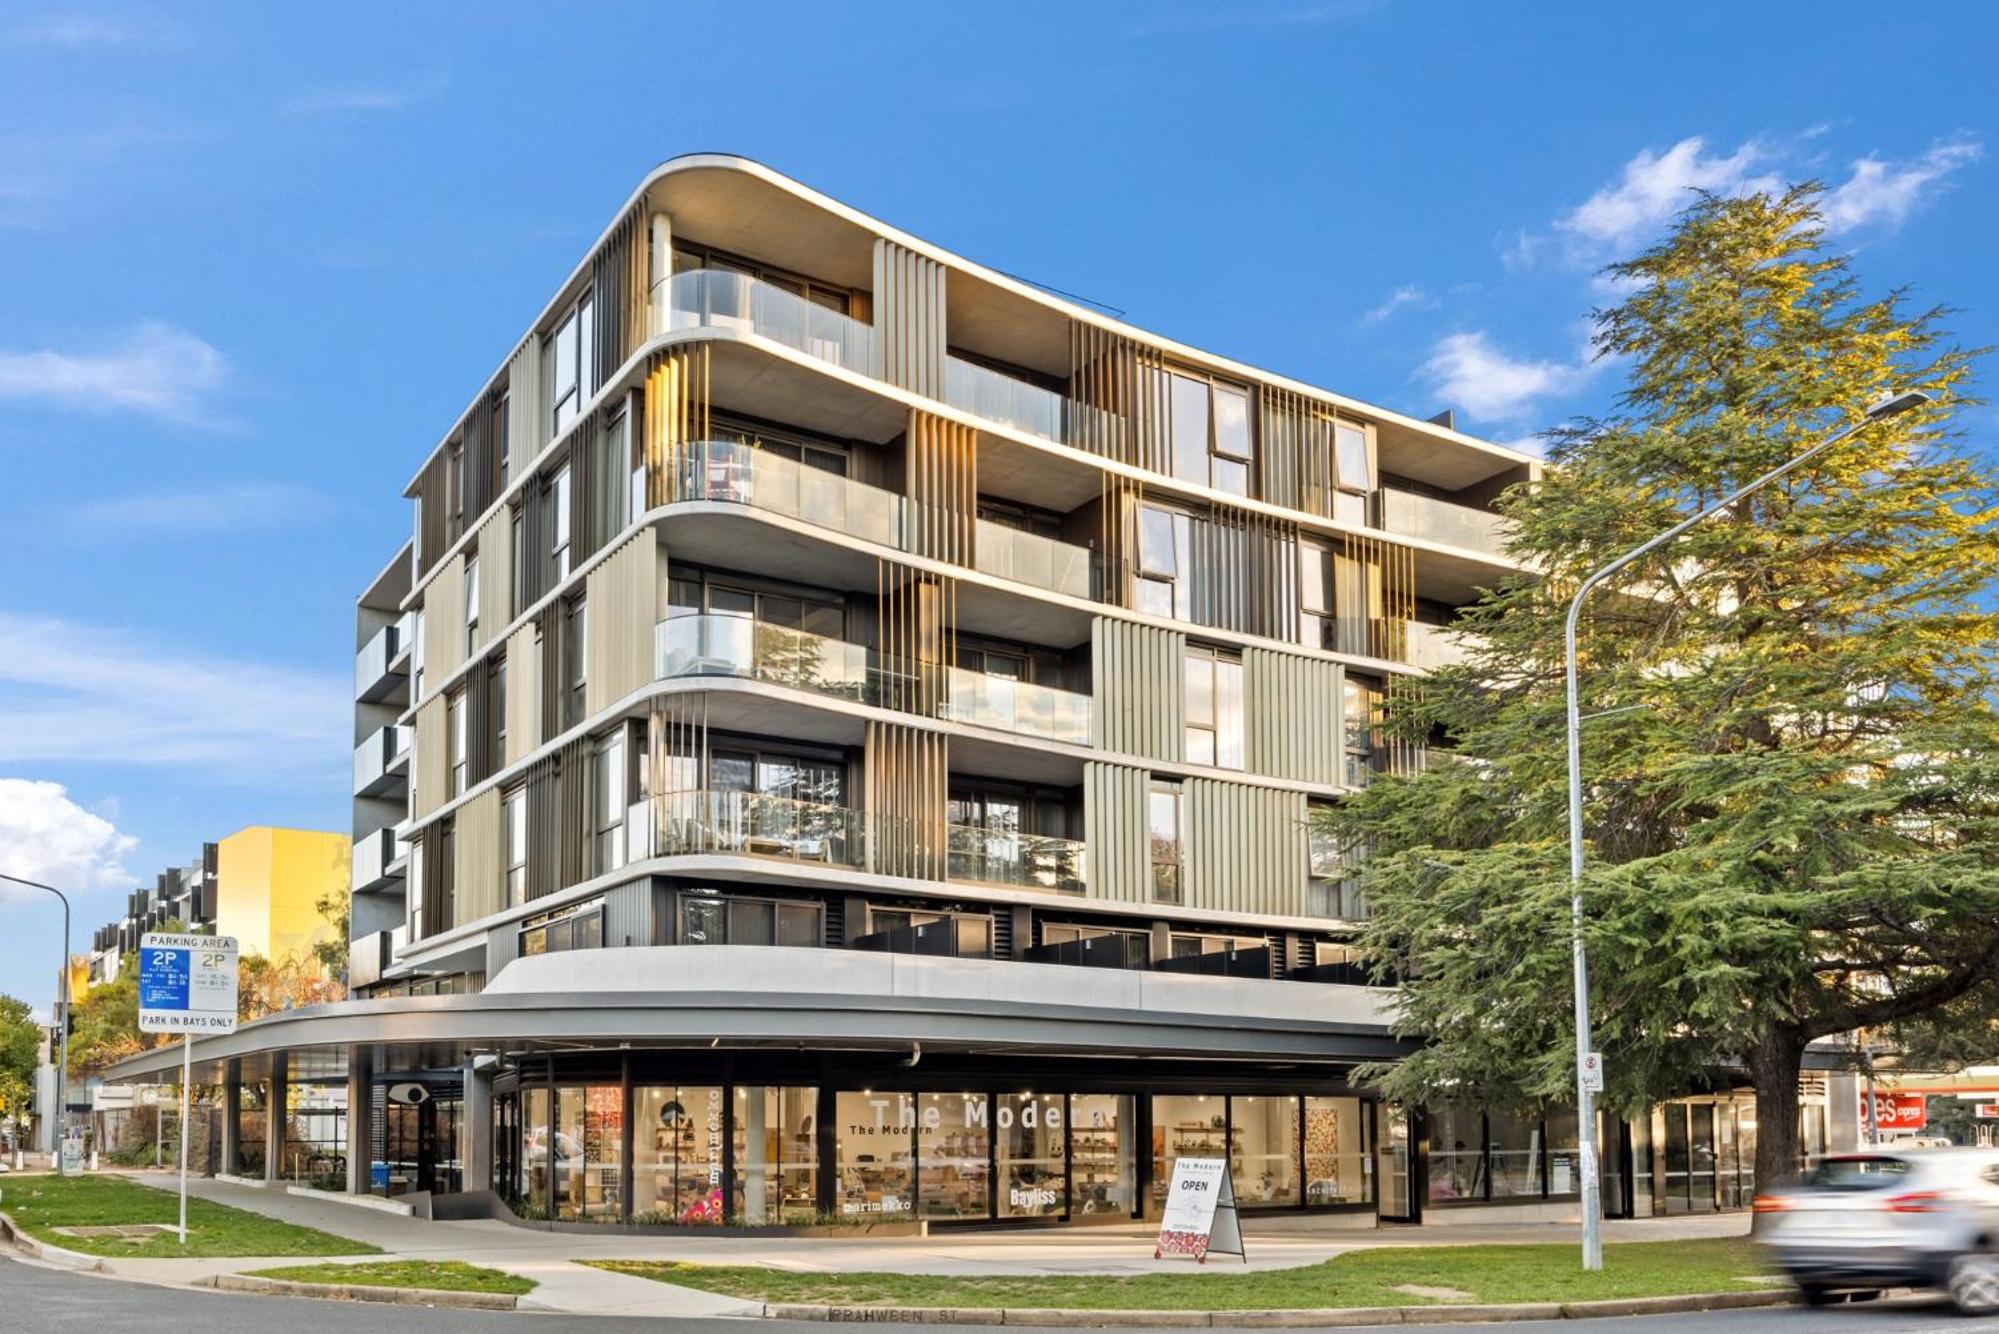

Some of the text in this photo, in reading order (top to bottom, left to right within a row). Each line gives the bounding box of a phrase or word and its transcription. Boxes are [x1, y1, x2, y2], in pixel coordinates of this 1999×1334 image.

[150, 936, 230, 948] PARKING AREA
[153, 952, 177, 965] 2P
[203, 954, 225, 967] 2P
[142, 1016, 233, 1027] PARK IN BAYS ONLY
[869, 1098, 941, 1129] The
[849, 1125, 933, 1135] The Modrn
[1181, 1180, 1209, 1192] OPEN
[1010, 1188, 1057, 1208] Bayliss
